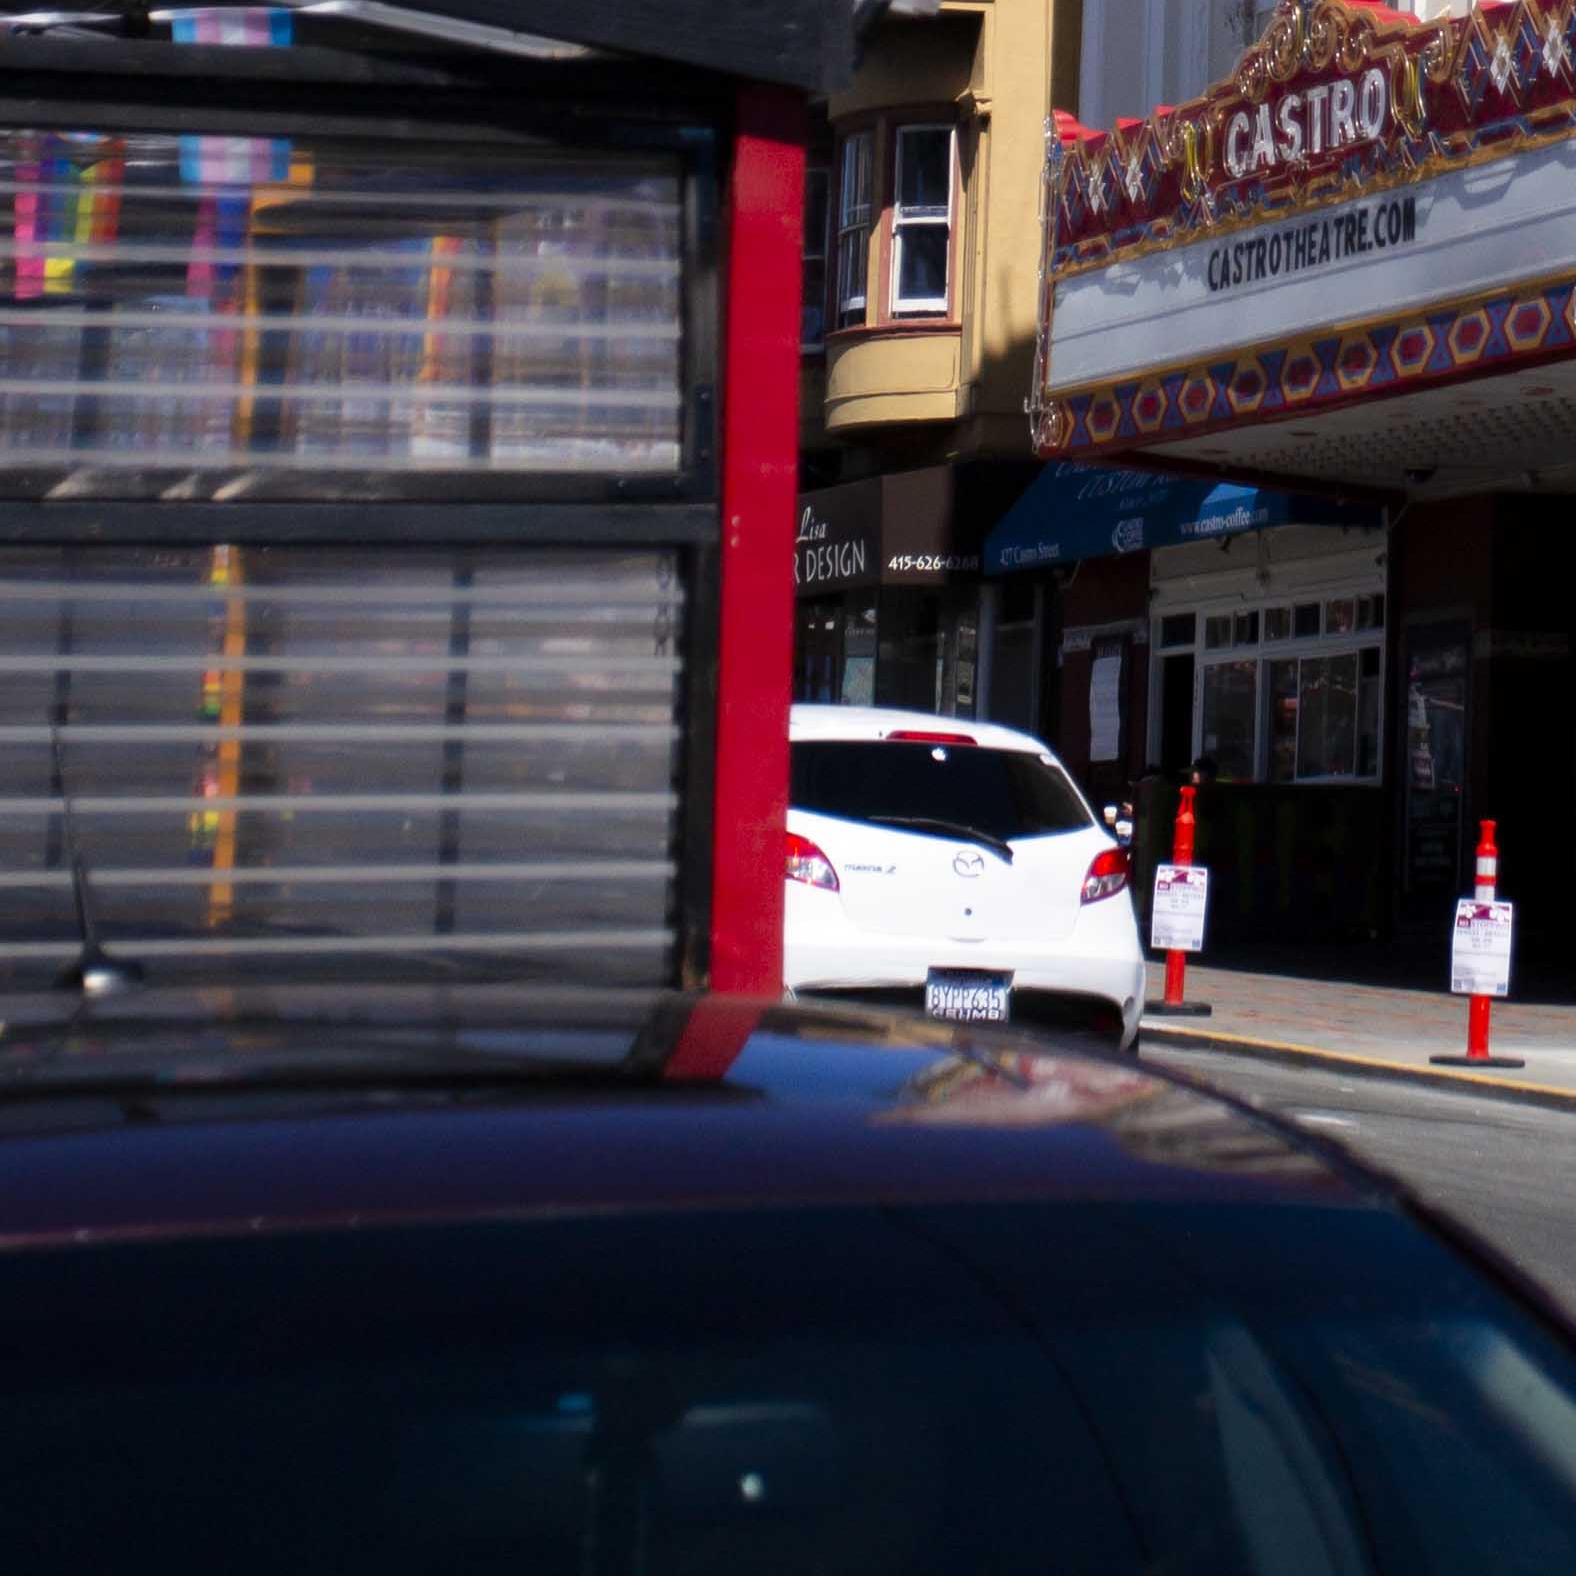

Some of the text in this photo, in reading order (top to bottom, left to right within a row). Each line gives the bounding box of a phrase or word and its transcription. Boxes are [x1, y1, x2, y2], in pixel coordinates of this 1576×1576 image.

[1225, 67, 1388, 178] CASTRO
[1207, 197, 1416, 291] CASTROTHEATRE.COM
[795, 504, 828, 544] Lisa
[805, 539, 865, 583] DESIGN
